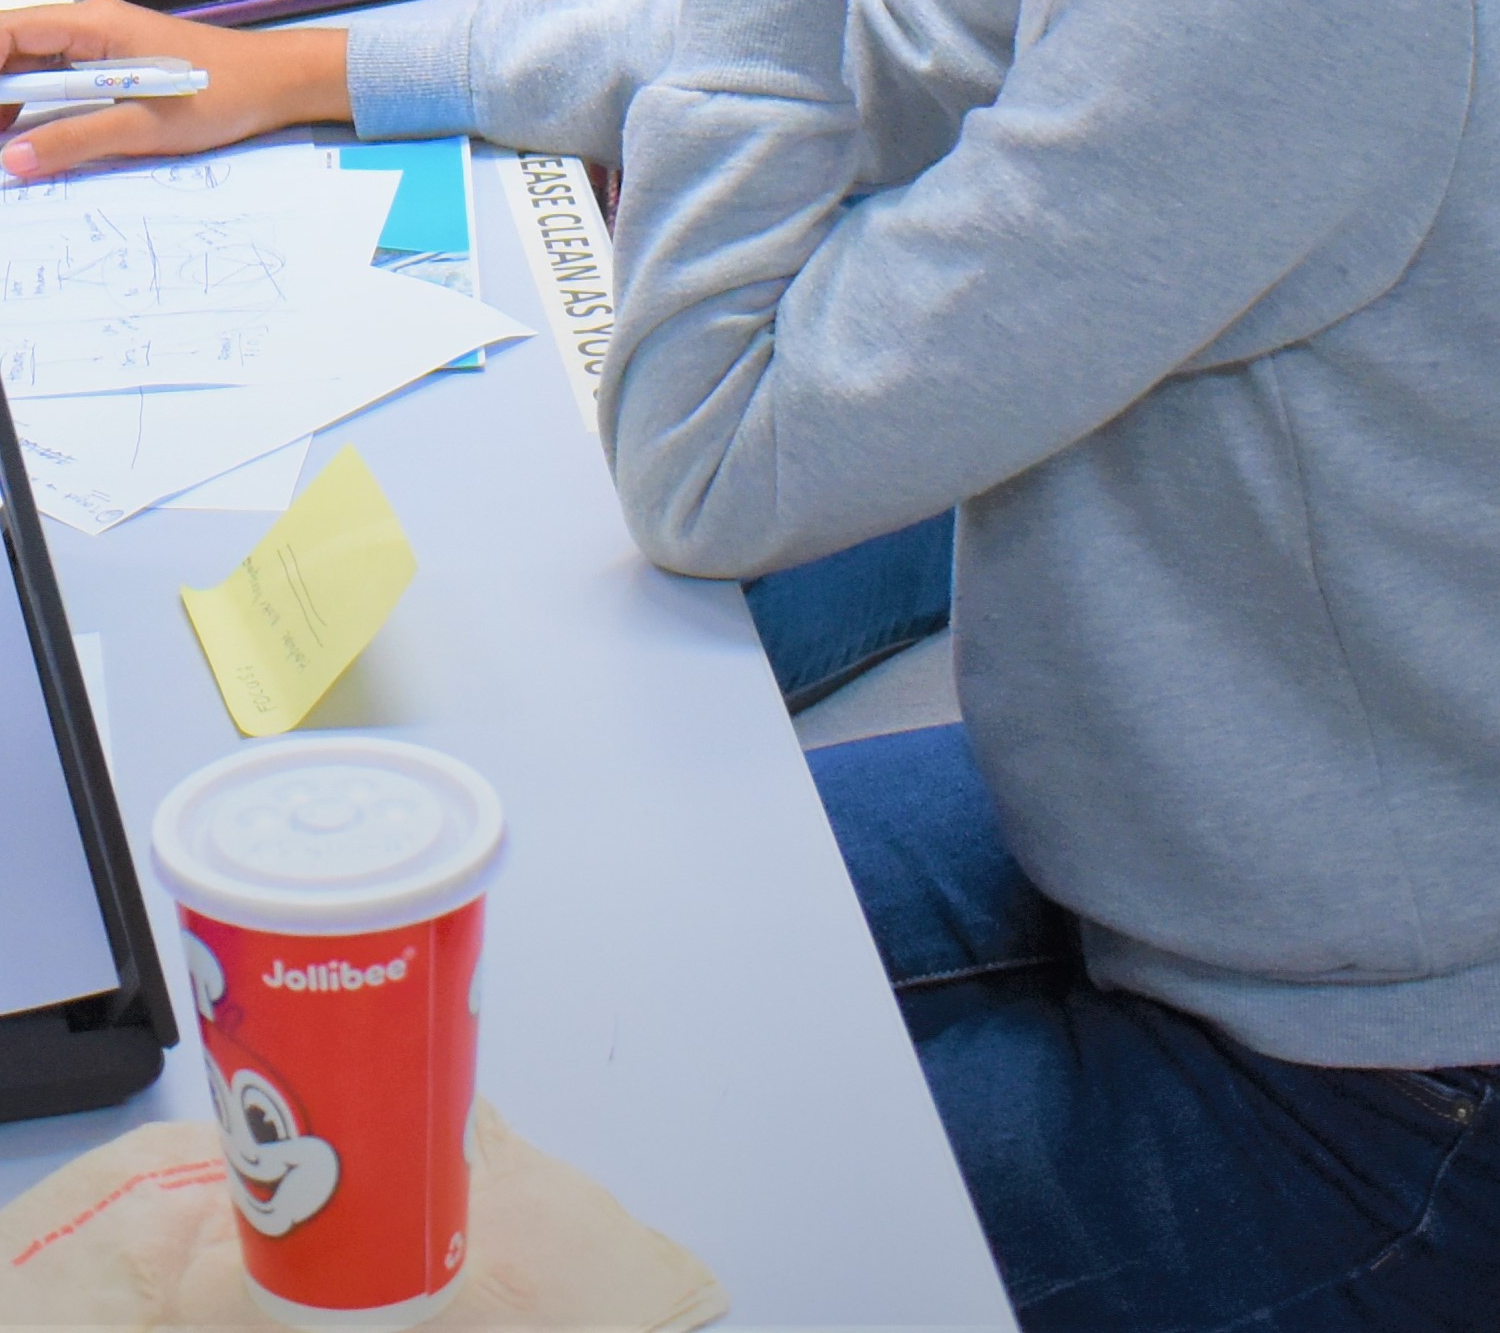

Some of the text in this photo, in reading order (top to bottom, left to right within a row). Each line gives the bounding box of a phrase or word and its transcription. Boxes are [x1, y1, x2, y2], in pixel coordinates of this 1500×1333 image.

[94, 72, 140, 89] Google
[536, 214, 601, 282] CLEAN
[559, 289, 613, 318] AS
[261, 958, 408, 992] Jollibee
